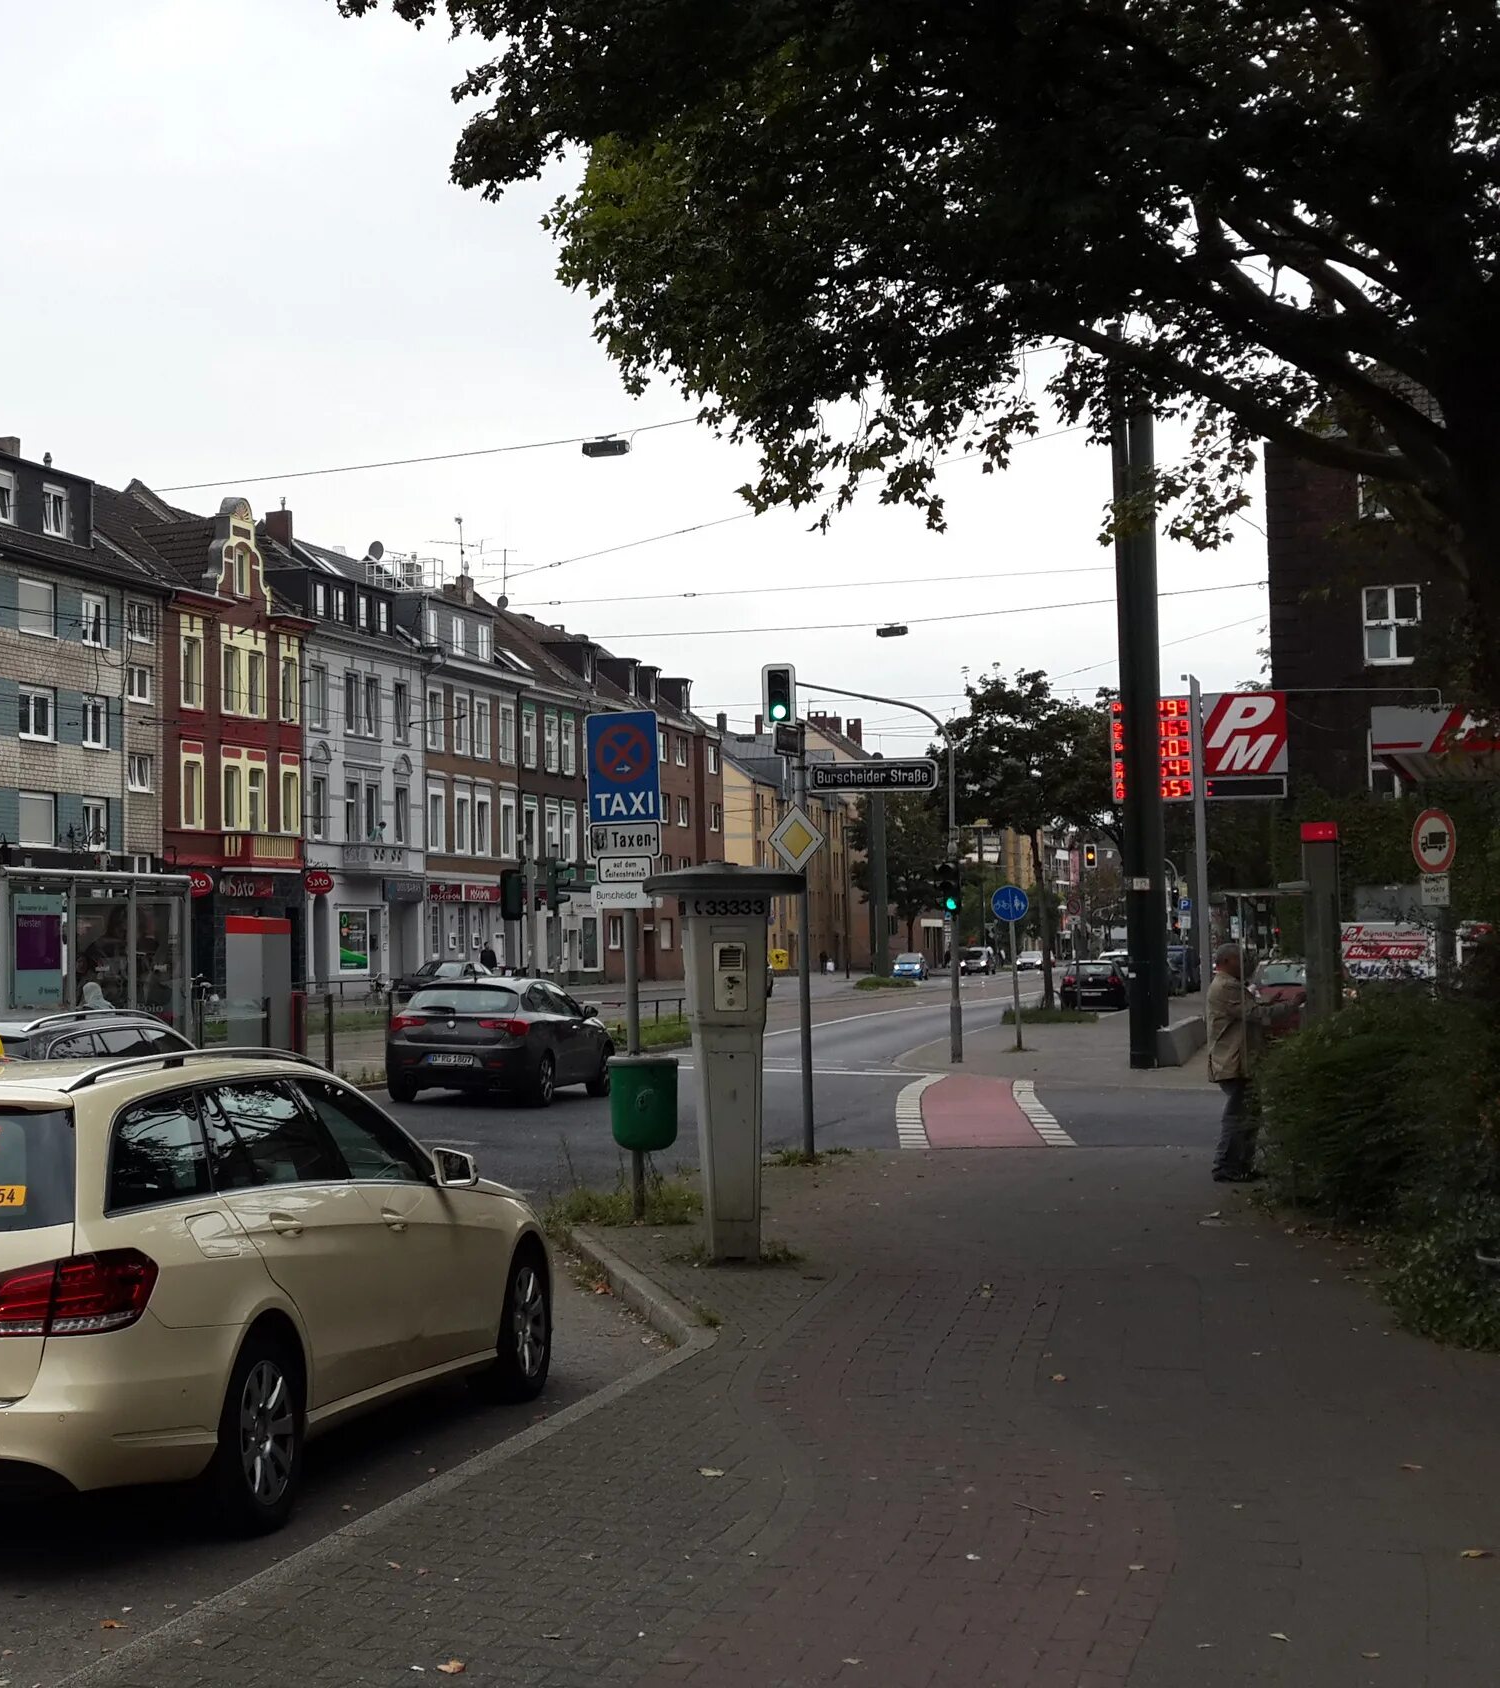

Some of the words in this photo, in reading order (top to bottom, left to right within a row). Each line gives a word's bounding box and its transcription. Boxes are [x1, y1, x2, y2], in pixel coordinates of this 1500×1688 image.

[817, 771, 886, 784] Burscheider
[890, 769, 929, 783] Straße
[595, 791, 654, 816] TAXI
[612, 832, 652, 848] Taxen
[613, 860, 623, 868] auf
[625, 860, 637, 868] dem
[605, 868, 647, 878] Seitenstreifen
[190, 878, 206, 888] ato
[306, 876, 329, 887] Sato
[596, 891, 638, 900] Burscheider
[706, 900, 765, 916] 33333
